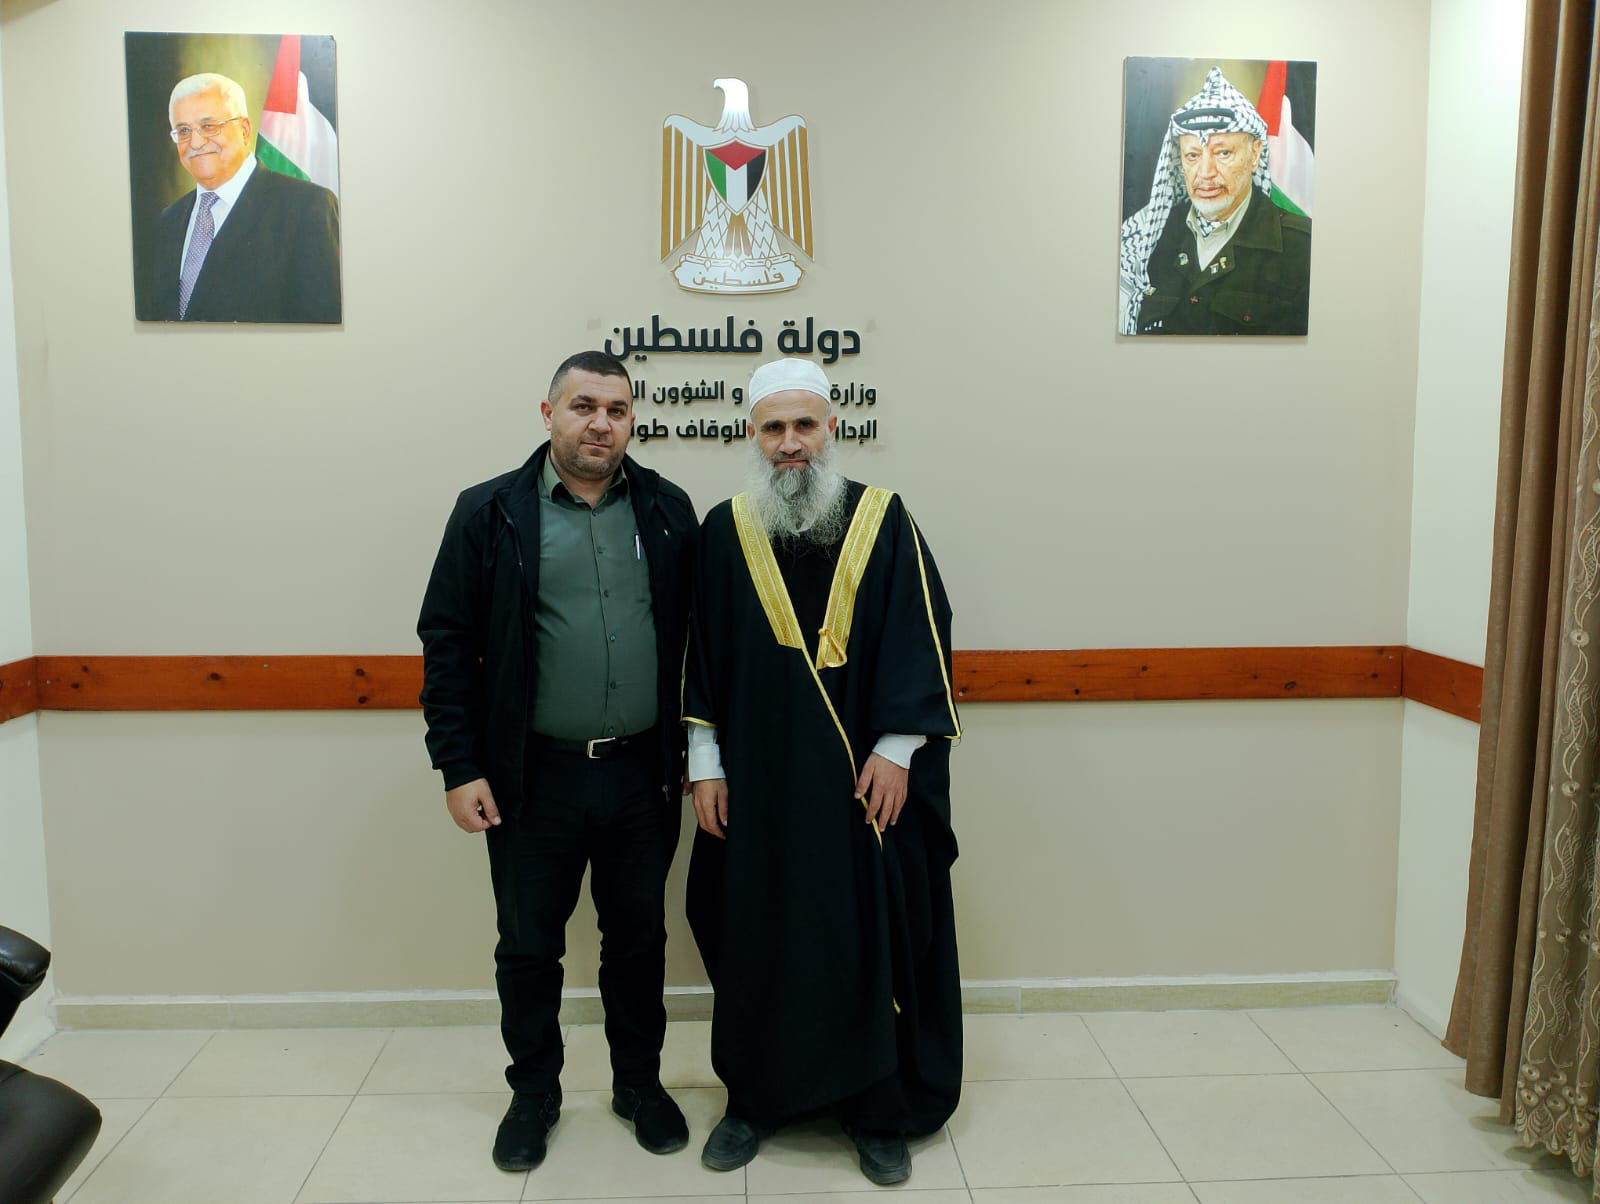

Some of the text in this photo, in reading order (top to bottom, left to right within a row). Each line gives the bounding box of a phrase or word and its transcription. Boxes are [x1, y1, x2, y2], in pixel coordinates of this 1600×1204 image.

[692, 267, 784, 289] فلسطين
[604, 314, 861, 364] دولة فلسطين
[652, 379, 724, 404] الشؤون
[731, 387, 743, 405] و
[829, 382, 876, 406] وزارة
[676, 418, 747, 442] لأوقاف
[835, 419, 877, 443] الإدار
